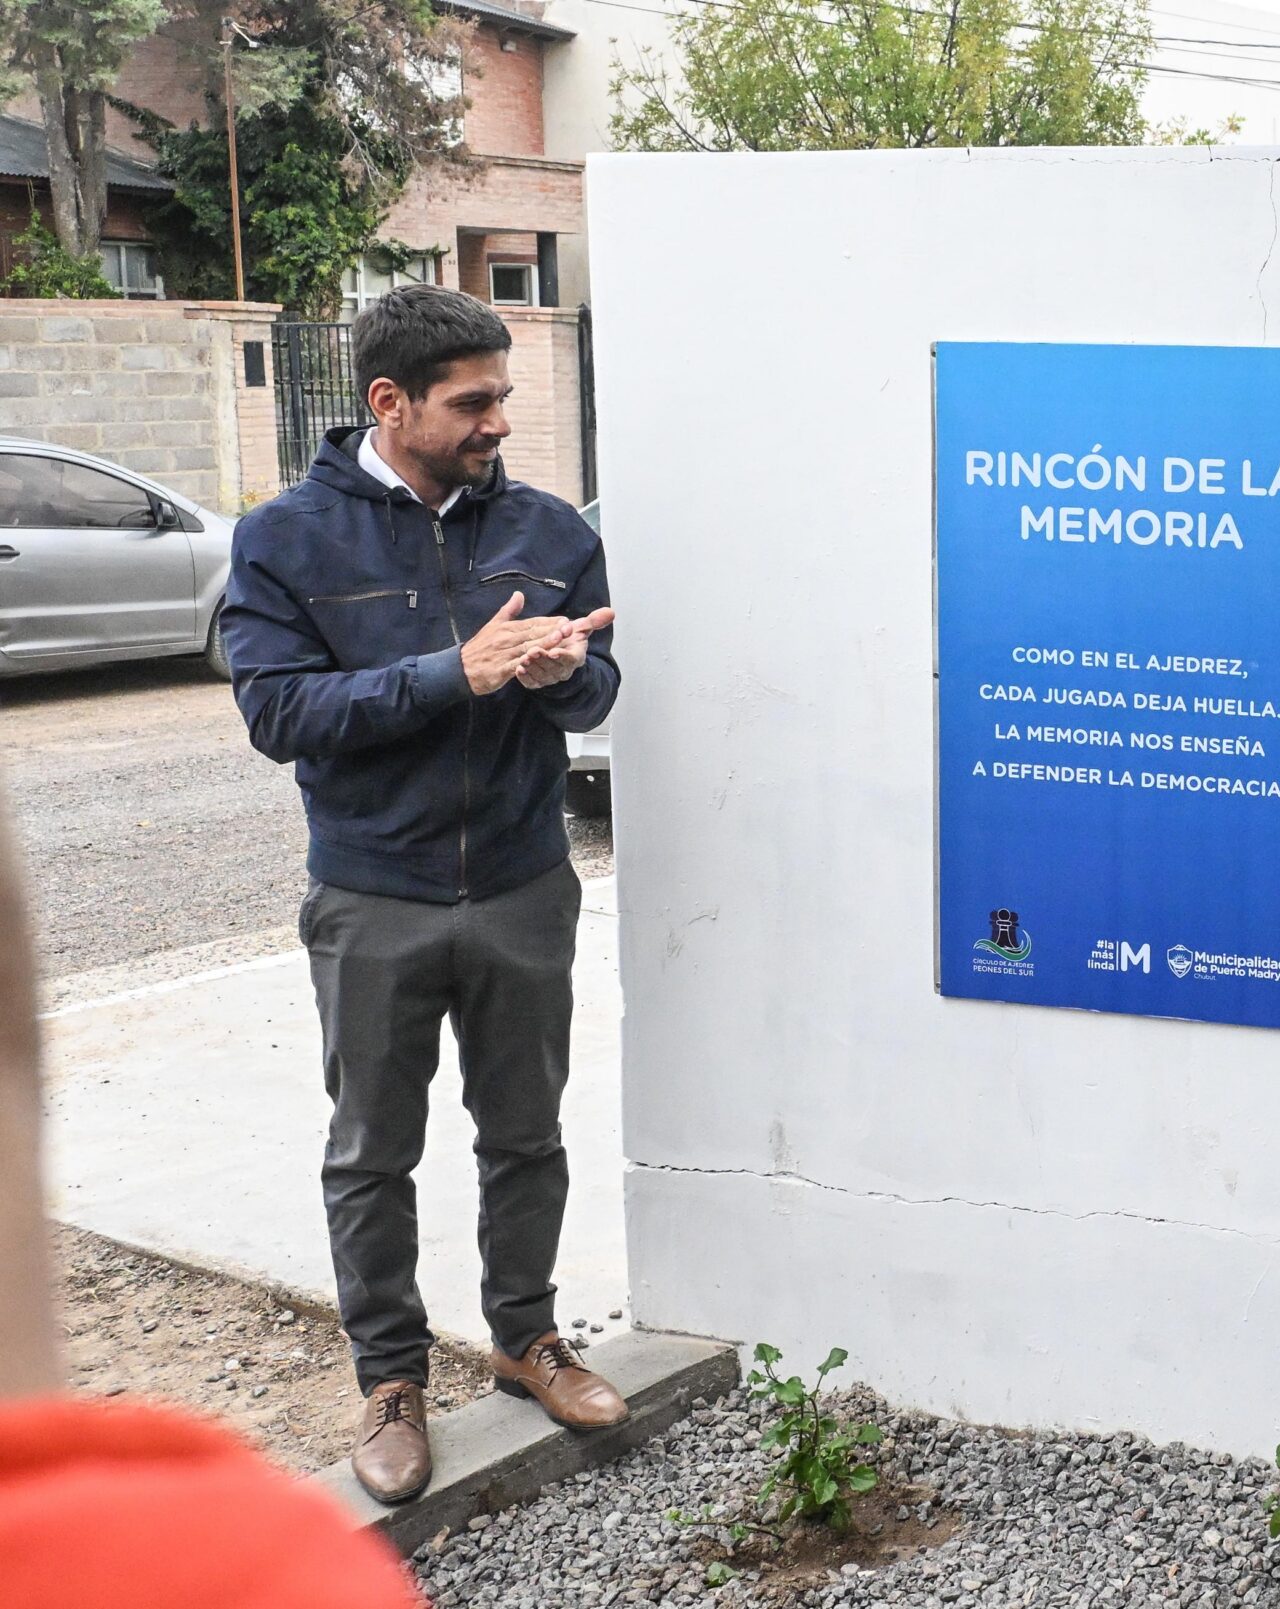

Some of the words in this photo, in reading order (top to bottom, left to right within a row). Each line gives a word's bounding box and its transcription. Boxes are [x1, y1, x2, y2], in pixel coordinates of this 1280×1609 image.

[966, 443, 1146, 492] RINCÓN
[1163, 457, 1226, 495] DE
[1021, 505, 1243, 549] MEMORIA
[1012, 647, 1075, 666] COMO
[1082, 651, 1108, 668] EN
[1116, 653, 1140, 670] EL
[1146, 655, 1249, 680] AJEDREZ,
[979, 684, 1037, 703] CADA
[1042, 688, 1127, 708] JUGADA
[1133, 694, 1187, 712] DEJA
[995, 724, 1020, 740] LA
[1027, 726, 1123, 748] MEMORIA
[1130, 733, 1174, 751] NOS
[1181, 736, 1265, 757] ENSEÑA
[973, 761, 987, 776] A
[993, 762, 1102, 784] DEFENDER
[1108, 770, 1135, 787] LA
[1091, 950, 1114, 960] más
[1096, 940, 1114, 950] #la
[1121, 941, 1151, 974] M
[973, 965, 1001, 974] PEONES
[1018, 969, 1034, 977] SUR
[1088, 959, 1115, 971] linda
[1194, 963, 1208, 973] de
[1210, 965, 1246, 977] Puerto
[1194, 973, 1216, 981] Chubut
